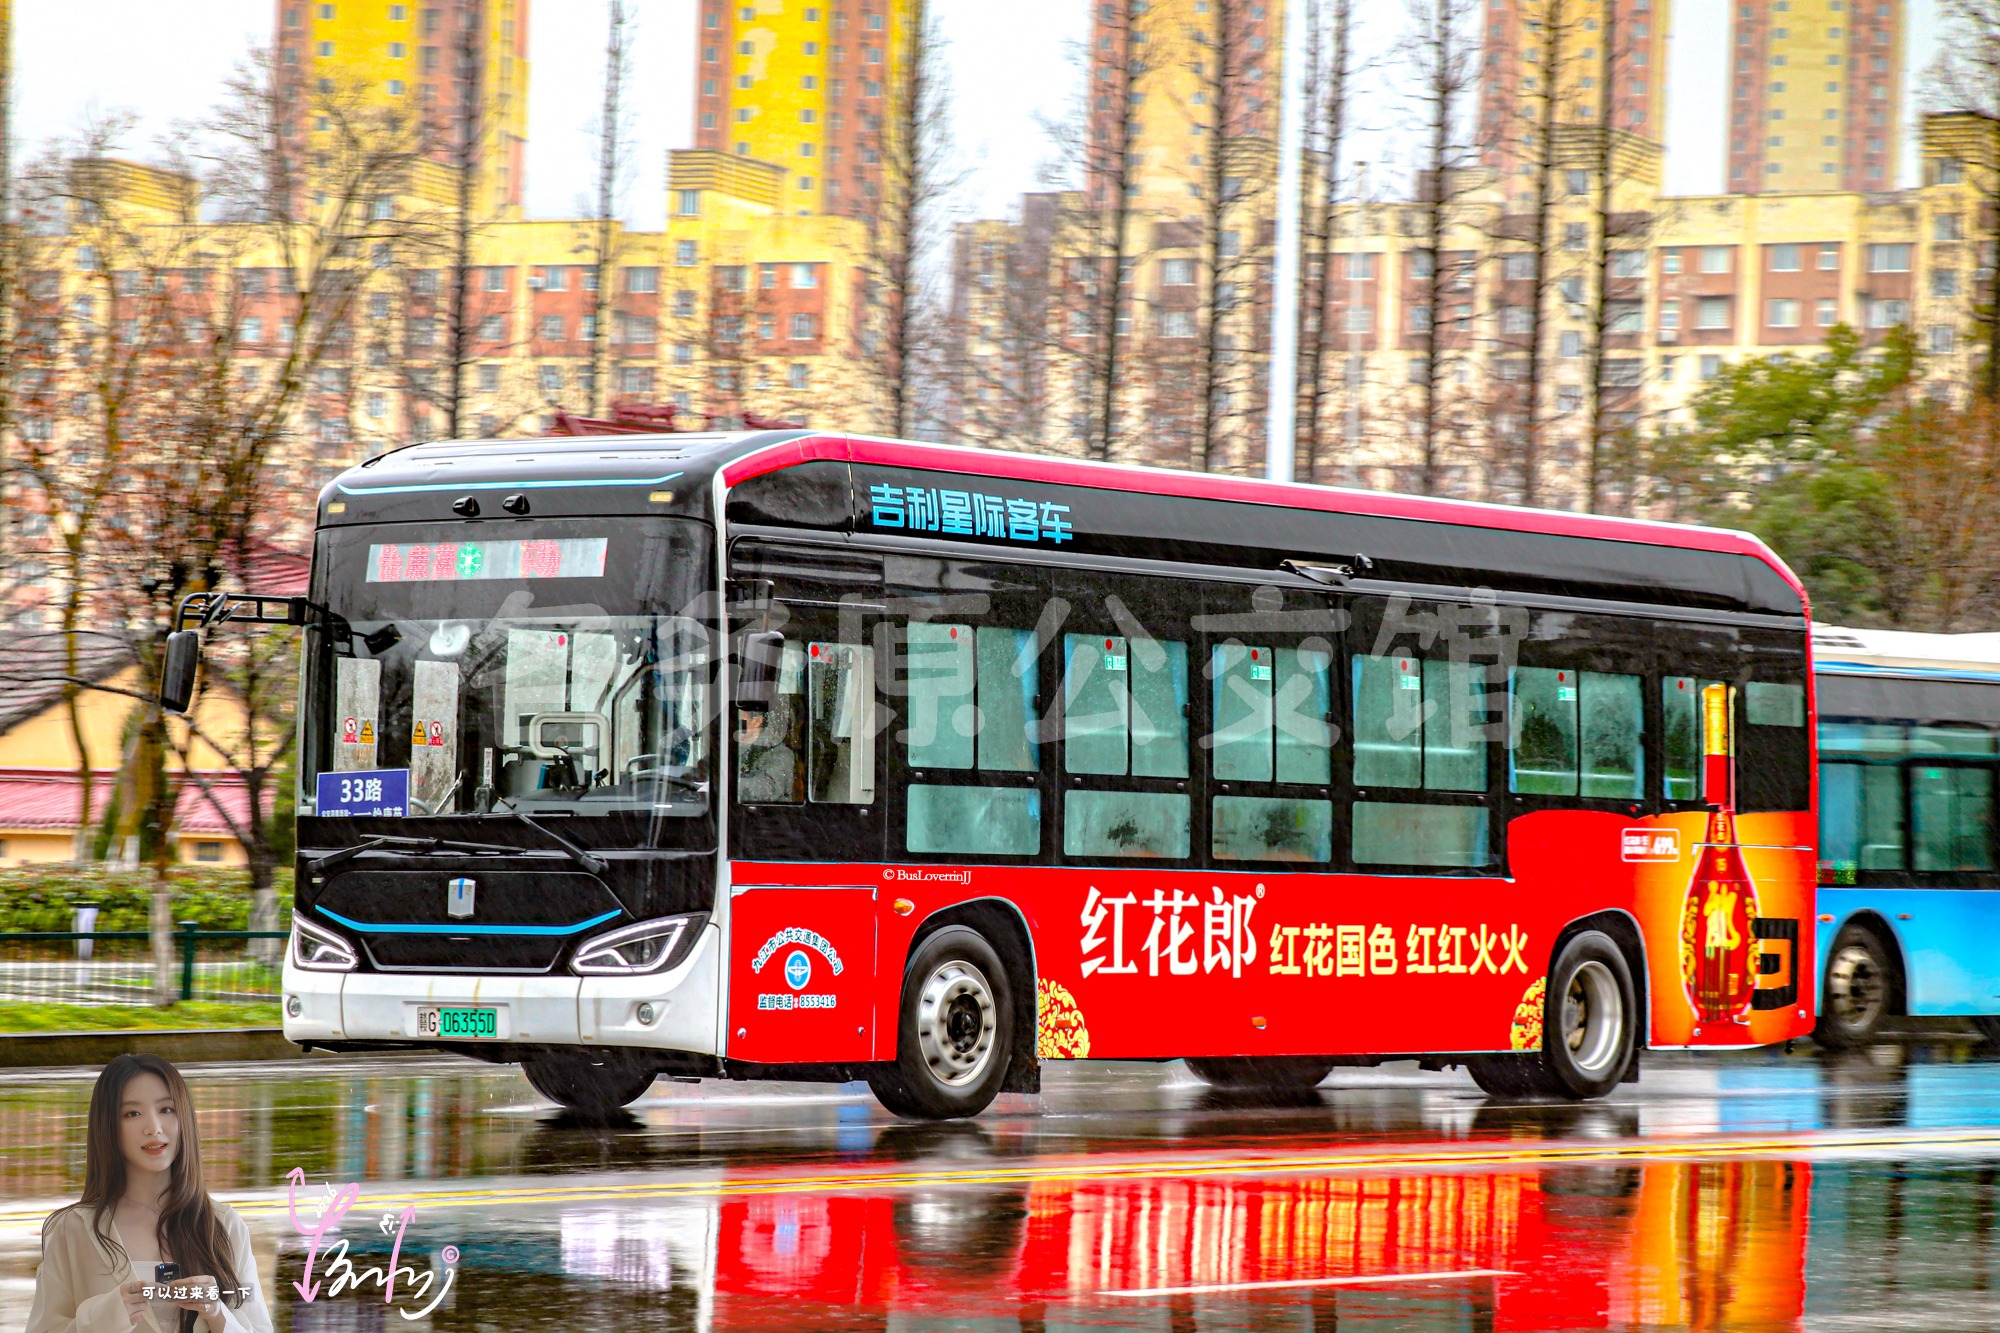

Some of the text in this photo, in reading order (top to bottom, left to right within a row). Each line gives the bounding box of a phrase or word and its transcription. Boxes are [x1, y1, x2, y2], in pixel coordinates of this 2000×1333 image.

[869, 482, 1073, 544] 吉利星际客车
[340, 777, 382, 803] 33路
[752, 927, 844, 976] 九江市公共交通集团公司
[1269, 923, 1529, 977] 红花国色 红红火火
